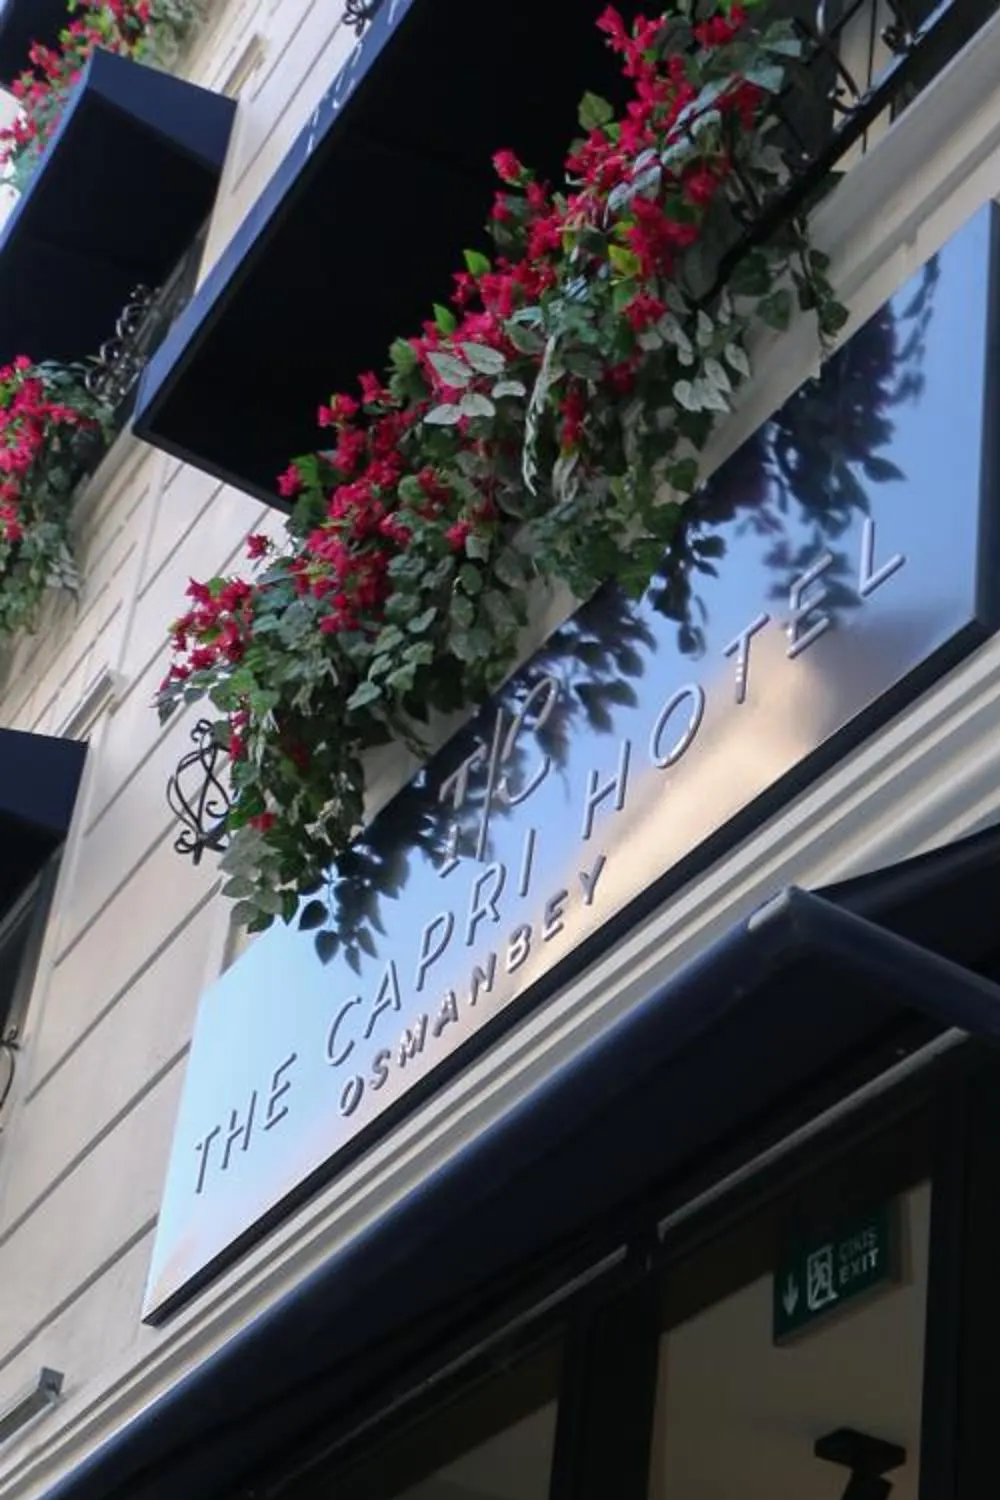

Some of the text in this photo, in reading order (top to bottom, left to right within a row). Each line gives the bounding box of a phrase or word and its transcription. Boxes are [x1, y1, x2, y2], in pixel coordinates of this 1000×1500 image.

[194, 518, 906, 1195] THE CAPRI HOTEL
[339, 855, 607, 1117] OSMANBEY
[839, 1248, 879, 1285] EXIT
